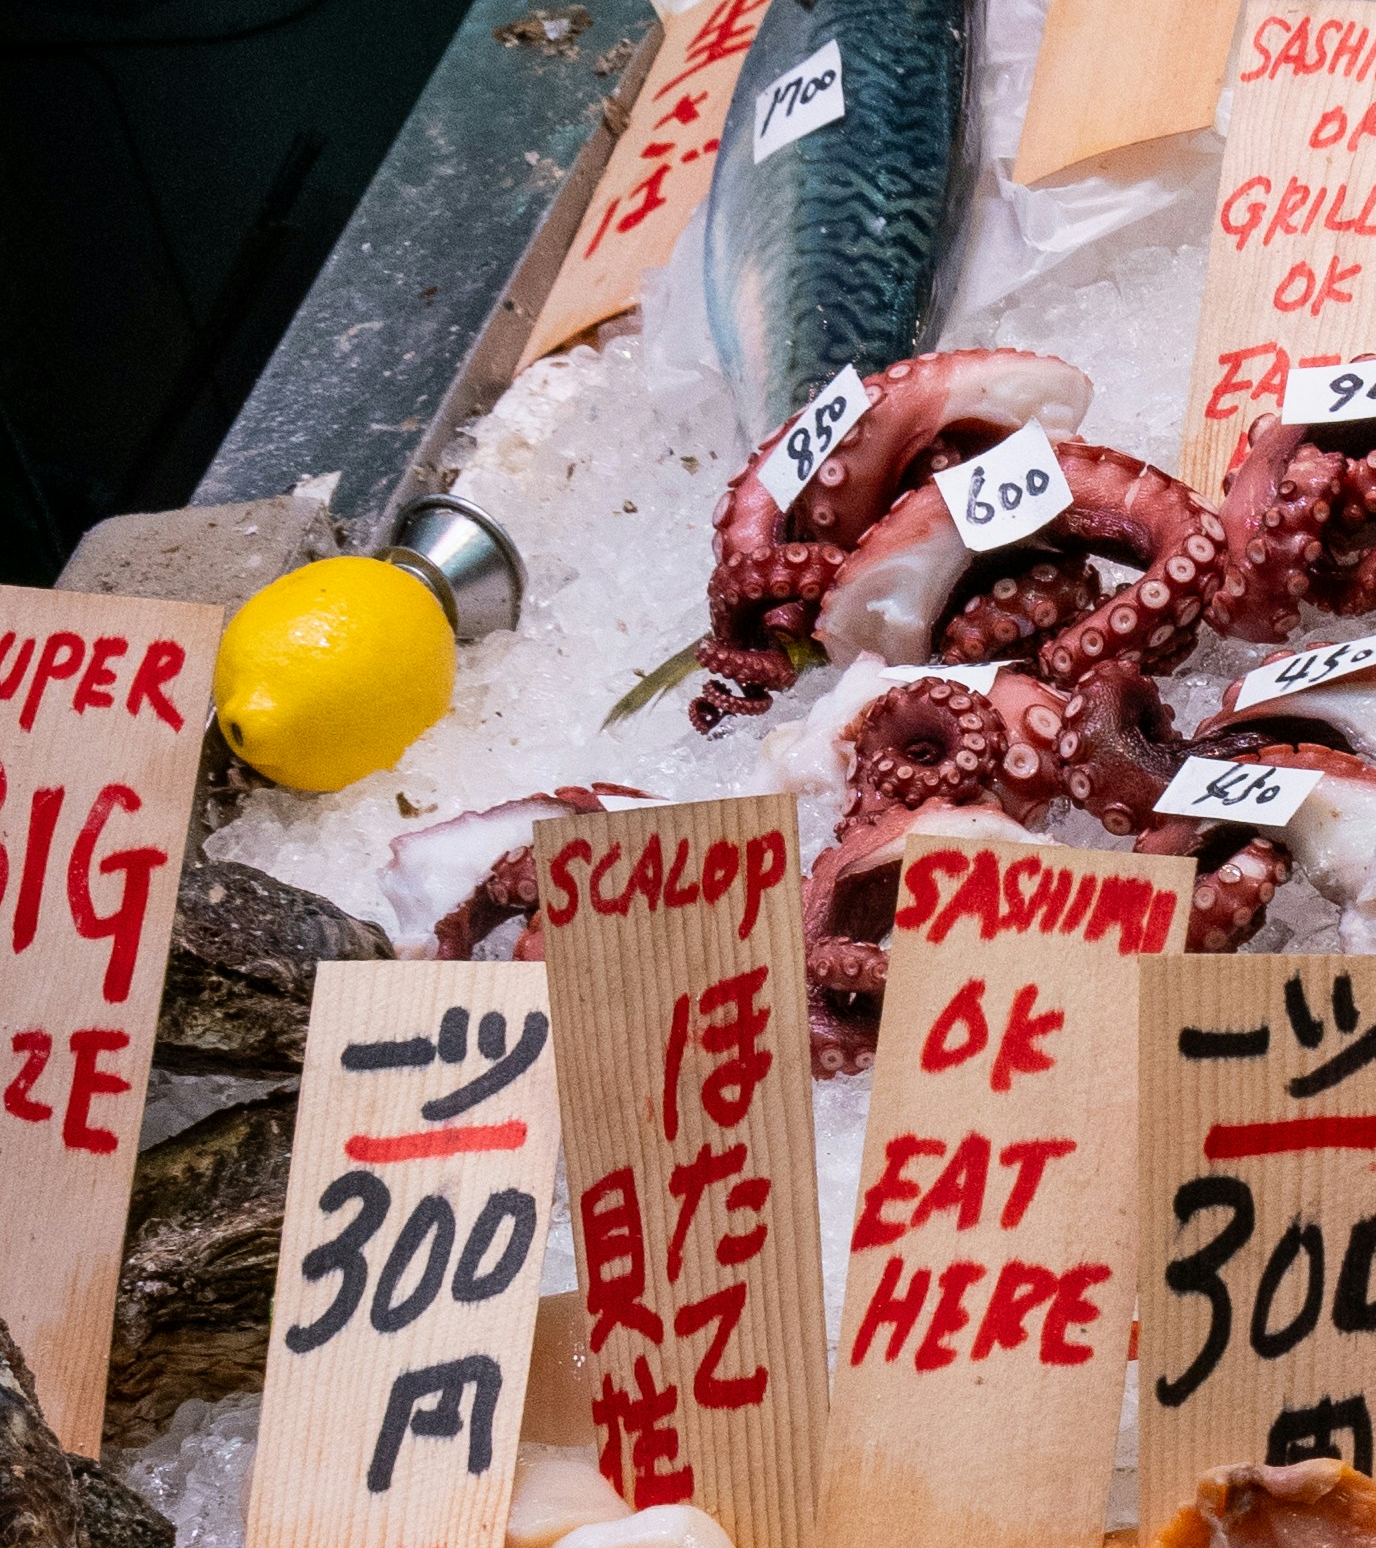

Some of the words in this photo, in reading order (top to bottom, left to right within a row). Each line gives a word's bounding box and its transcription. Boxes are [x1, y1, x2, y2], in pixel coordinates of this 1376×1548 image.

[758, 68, 838, 138] 1700
[1273, 255, 1361, 316] OK
[786, 393, 849, 478] 850
[965, 463, 1051, 527] 600
[1276, 643, 1374, 689] 450
[0, 762, 168, 1002] IG
[547, 830, 785, 939] SCALOP
[893, 849, 1176, 957] SASHIMI
[341, 1007, 548, 1121] 一ツ
[919, 977, 1066, 1092] OK
[663, 965, 772, 1411] ほたて
[851, 1131, 1077, 1253] EAT
[286, 1171, 536, 1353] 300
[850, 1255, 1112, 1374] HERE
[368, 1355, 502, 1493] 円
